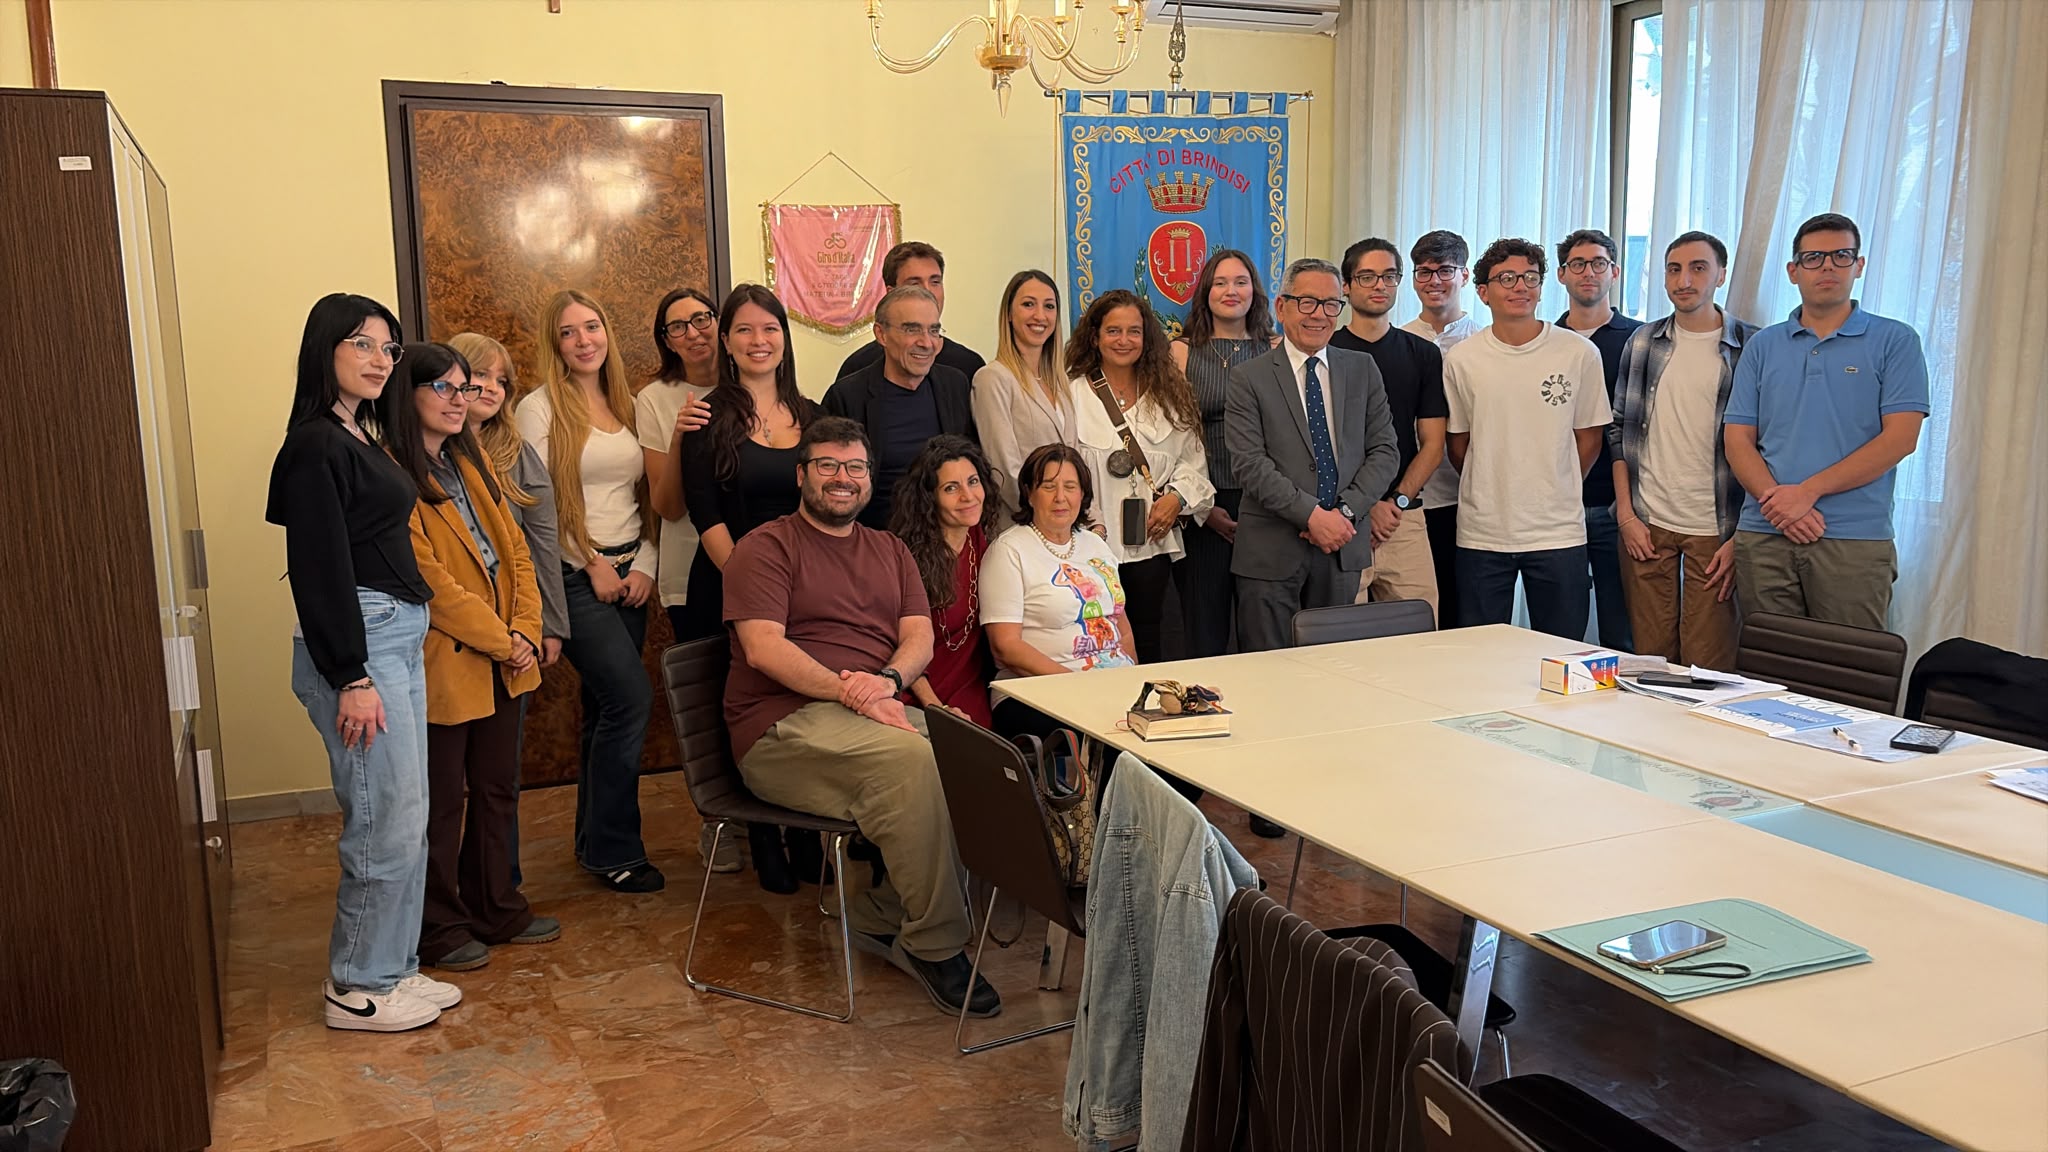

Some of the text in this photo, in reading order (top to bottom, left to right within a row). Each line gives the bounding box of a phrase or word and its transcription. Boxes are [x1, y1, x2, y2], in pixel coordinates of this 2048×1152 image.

[1157, 148, 1176, 166] DI
[1181, 149, 1251, 194] BRINDISI
[817, 251, 832, 264] Giro
